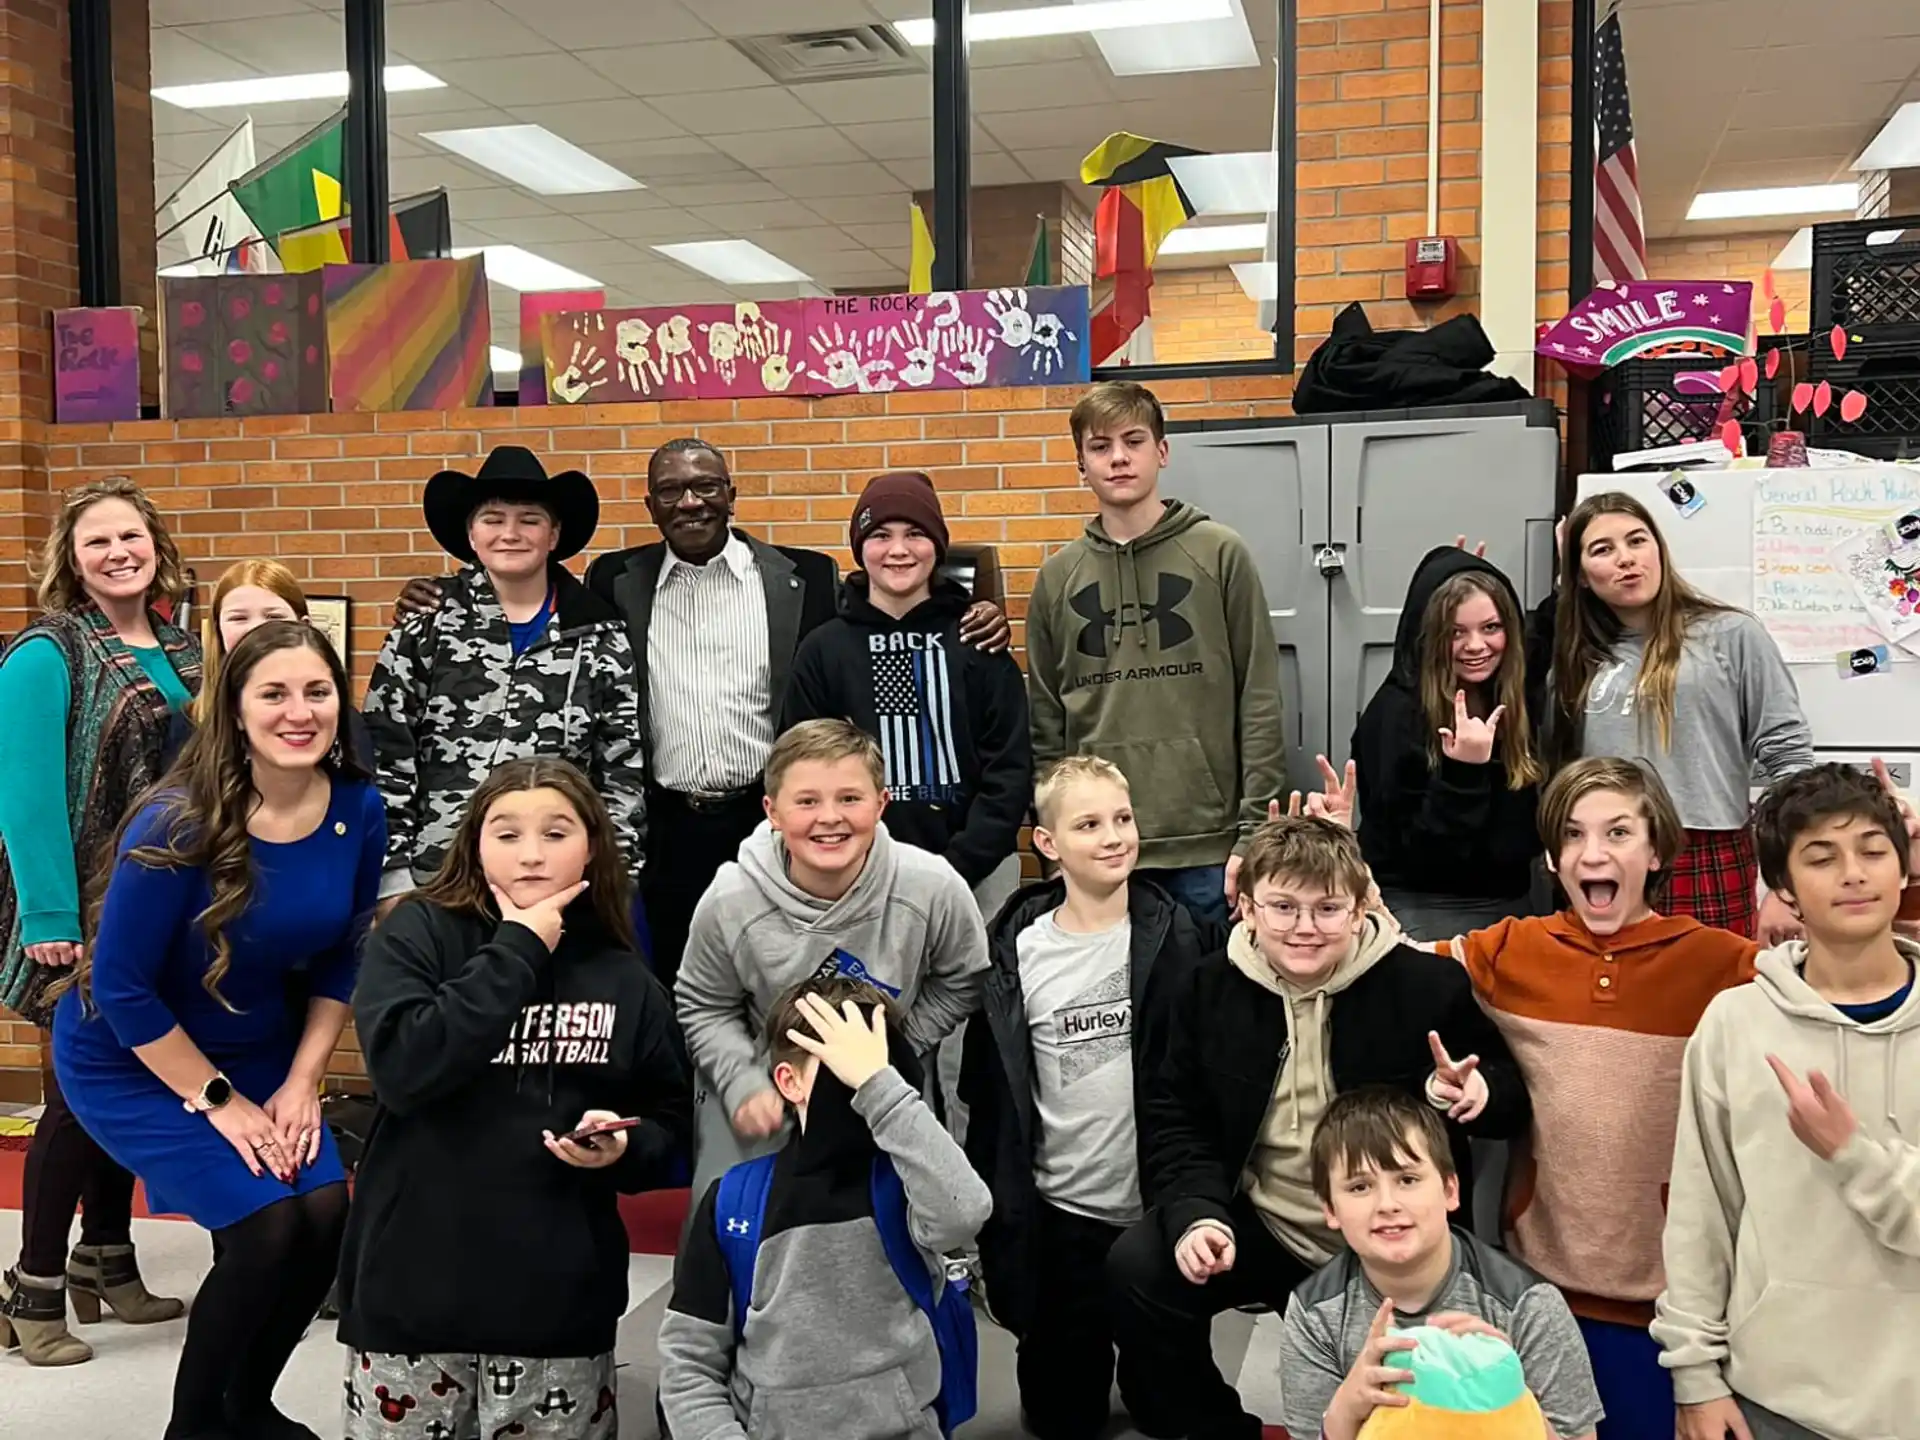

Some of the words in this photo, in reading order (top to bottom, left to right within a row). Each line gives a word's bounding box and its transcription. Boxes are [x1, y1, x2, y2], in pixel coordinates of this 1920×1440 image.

[824, 297, 858, 314] THE
[869, 296, 918, 312] ROCK
[1570, 290, 1686, 343] SMILE
[869, 632, 944, 652] BACK
[1075, 671, 1123, 688] UNDER
[1125, 661, 1205, 681] ARMOUR
[1064, 1011, 1127, 1035] Hurley
